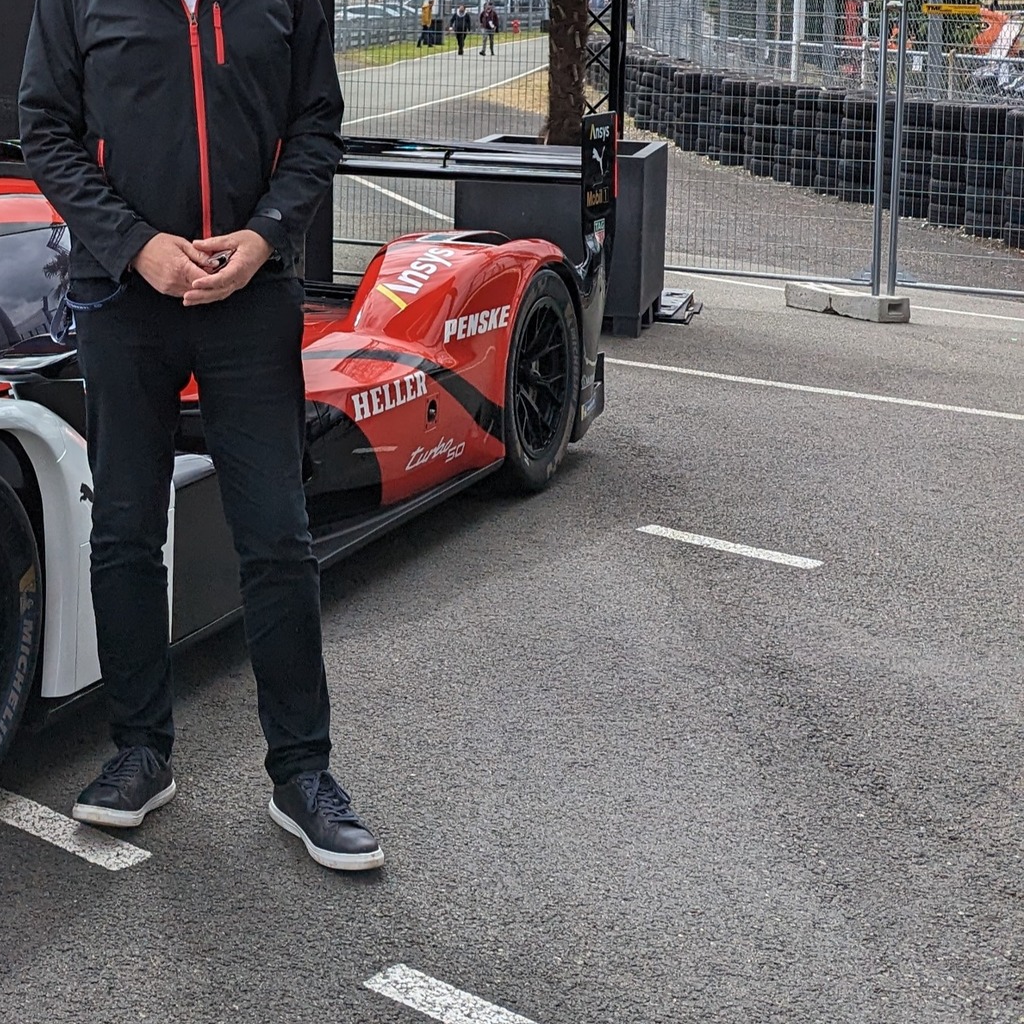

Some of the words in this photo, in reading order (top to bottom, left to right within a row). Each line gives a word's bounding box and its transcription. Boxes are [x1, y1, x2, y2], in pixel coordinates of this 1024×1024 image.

[589, 123, 610, 142] Ansys
[586, 189, 603, 208] Mobil
[376, 247, 456, 310] Ansys
[443, 304, 511, 344] PENSKE
[351, 370, 428, 422] HELLER
[404, 435, 455, 472] turbo
